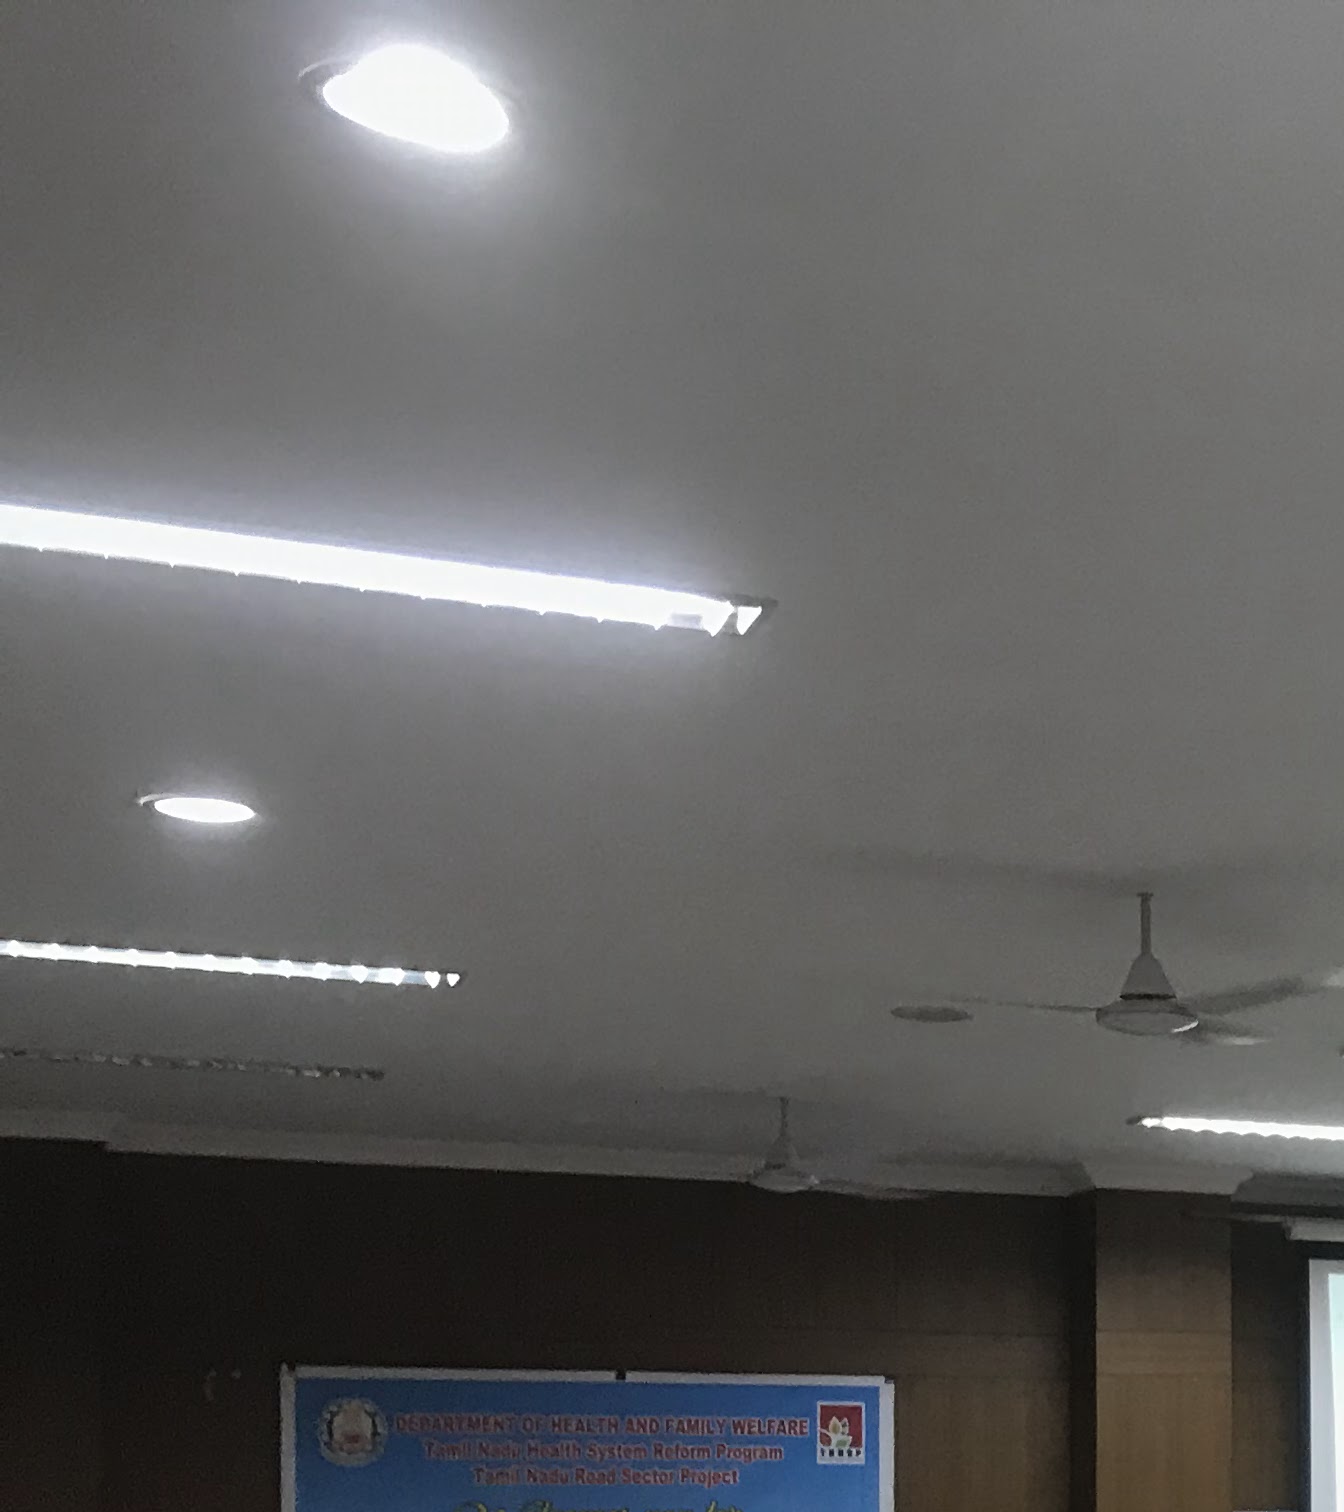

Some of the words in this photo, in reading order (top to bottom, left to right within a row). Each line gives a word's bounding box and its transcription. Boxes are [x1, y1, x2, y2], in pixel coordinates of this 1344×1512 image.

[395, 1413, 515, 1434] DEPARTMENT
[551, 1416, 620, 1434] HEALTH
[625, 1417, 661, 1435] AND
[665, 1417, 727, 1436] FAMILY
[731, 1418, 809, 1437] WELFARE
[477, 1441, 521, 1460] Nadu
[526, 1441, 582, 1460] Health
[587, 1442, 648, 1464] System
[653, 1443, 710, 1461] Reform
[716, 1443, 785, 1465] Program
[473, 1466, 520, 1485] Tamil
[526, 1466, 570, 1485] Nadu
[575, 1467, 617, 1485] Road
[622, 1468, 674, 1486] Sector
[680, 1468, 740, 1489] Project
